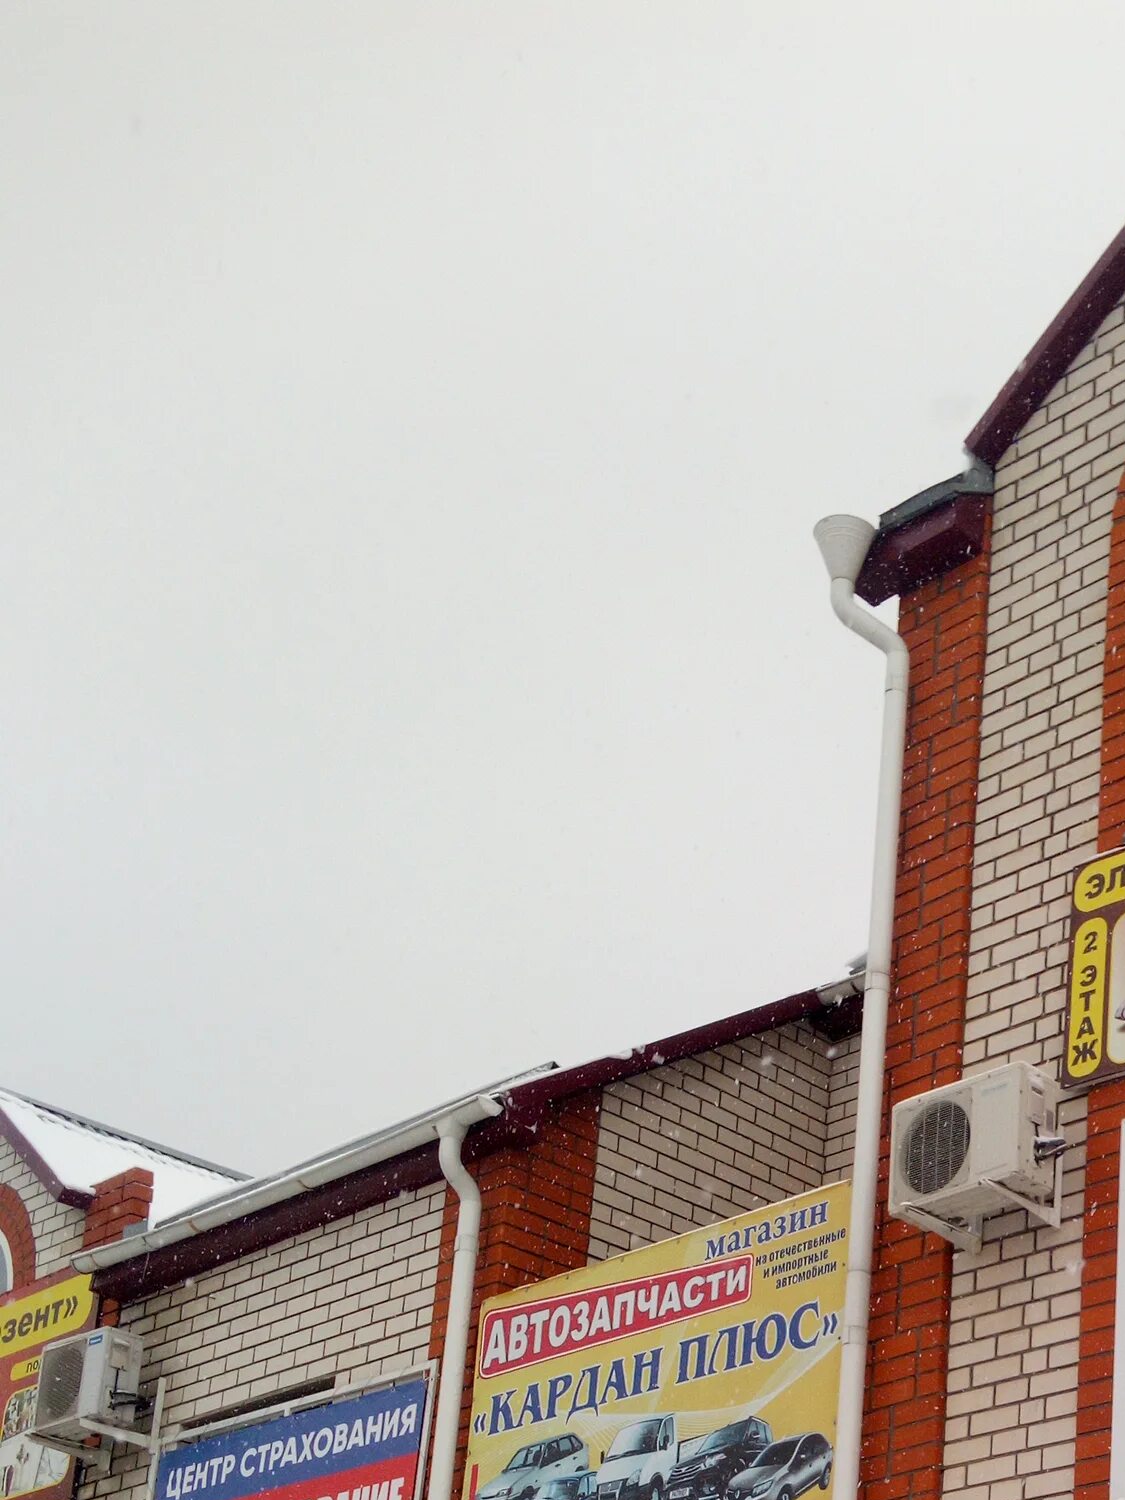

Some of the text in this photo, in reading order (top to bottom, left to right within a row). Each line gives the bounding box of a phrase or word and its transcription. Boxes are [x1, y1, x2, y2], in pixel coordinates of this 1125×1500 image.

[1071, 931, 1099, 1067] 2 ЭТАЖ
[704, 1200, 829, 1262] магазин
[756, 1228, 846, 1267] на отечественные
[763, 1249, 829, 1279] и импортные
[776, 1261, 837, 1289] автомобили
[483, 1264, 748, 1370] АВТОЗАПЧАСТИ
[473, 1302, 839, 1437] «КАРДАН ПЛЮС»
[166, 1403, 417, 1500] ЦЕНТР СТРАХОВАНИЯ
